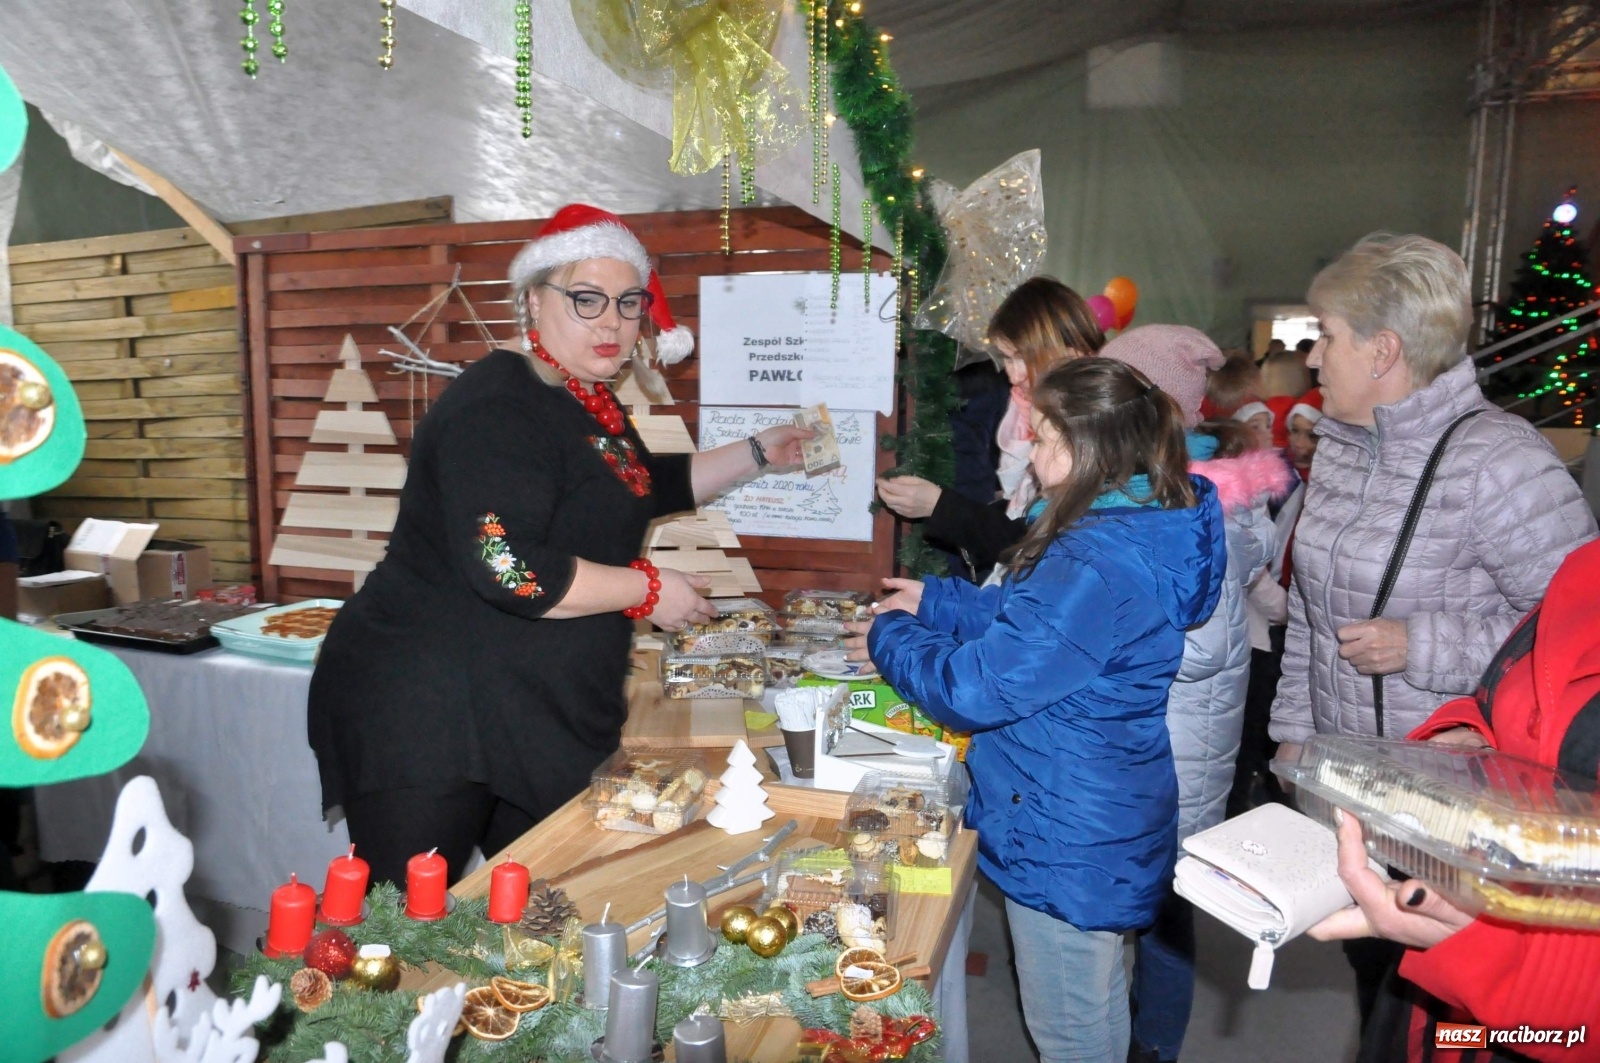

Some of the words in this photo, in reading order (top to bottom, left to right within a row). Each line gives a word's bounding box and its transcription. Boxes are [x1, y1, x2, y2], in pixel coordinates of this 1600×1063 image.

[743, 337, 782, 348] Zespół
[708, 410, 745, 425] Rada
[772, 480, 794, 491] 2020
